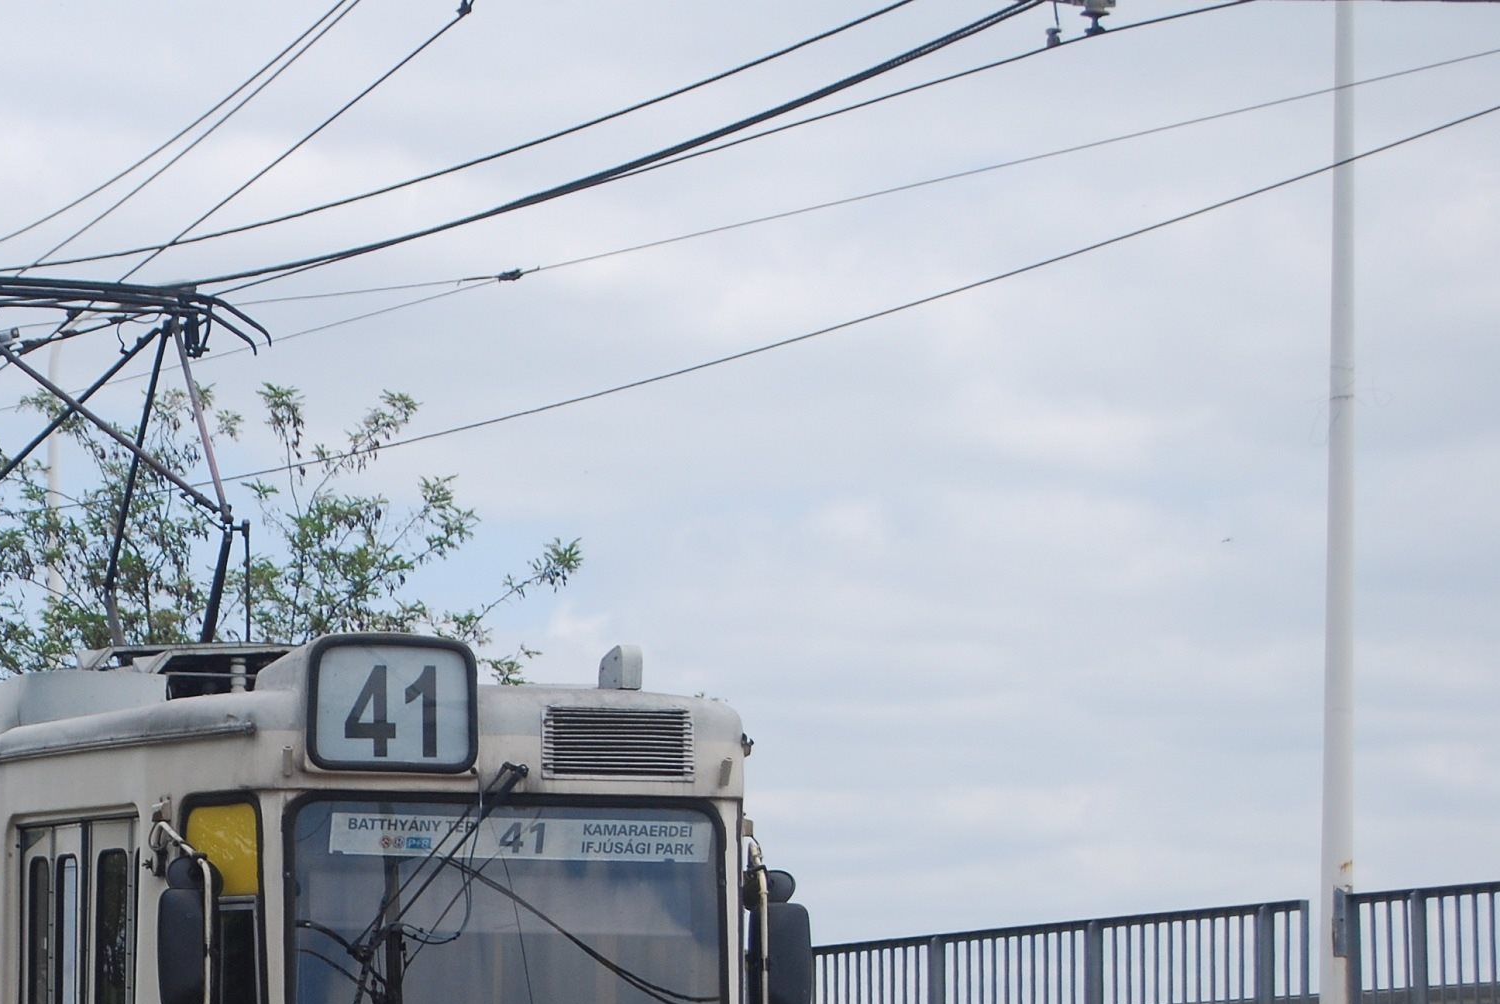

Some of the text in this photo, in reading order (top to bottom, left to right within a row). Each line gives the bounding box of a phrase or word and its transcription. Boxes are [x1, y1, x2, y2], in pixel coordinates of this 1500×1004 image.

[344, 664, 437, 758] 41
[348, 817, 441, 832] BATTHYÁNY
[583, 823, 693, 838] KAMARAERDEI
[499, 822, 546, 854] 41
[581, 838, 694, 855] IFJÚSÁGI PARK
